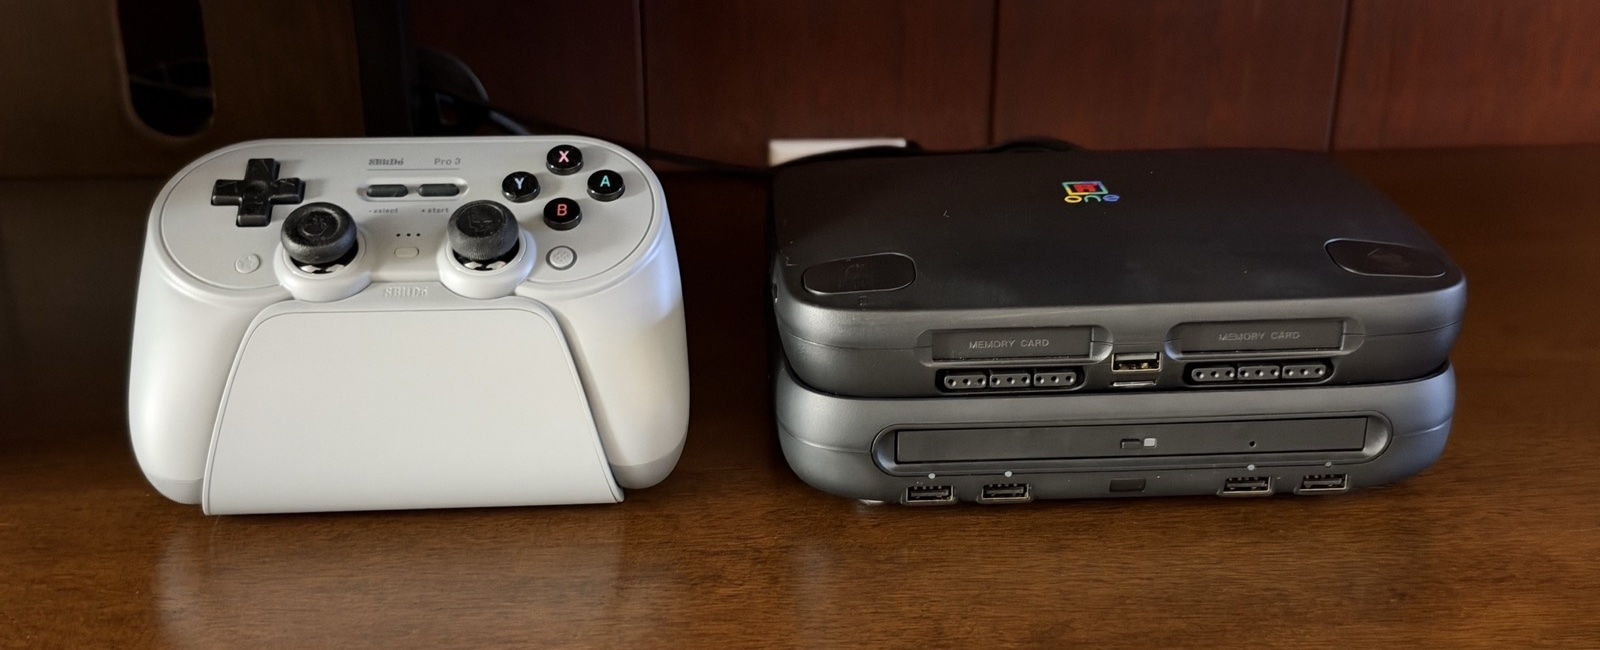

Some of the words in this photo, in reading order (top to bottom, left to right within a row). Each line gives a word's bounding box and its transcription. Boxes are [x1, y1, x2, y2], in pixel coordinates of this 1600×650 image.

[434, 157, 452, 166] Pro
[454, 157, 461, 166] 3
[559, 150, 569, 163] X
[514, 177, 525, 190] Y
[600, 175, 611, 187] A
[557, 203, 568, 216] B
[1218, 332, 1265, 341] MEMORY
[1270, 331, 1300, 340] CARD
[968, 339, 1016, 349] MEMORY
[1020, 338, 1050, 347] CARD
